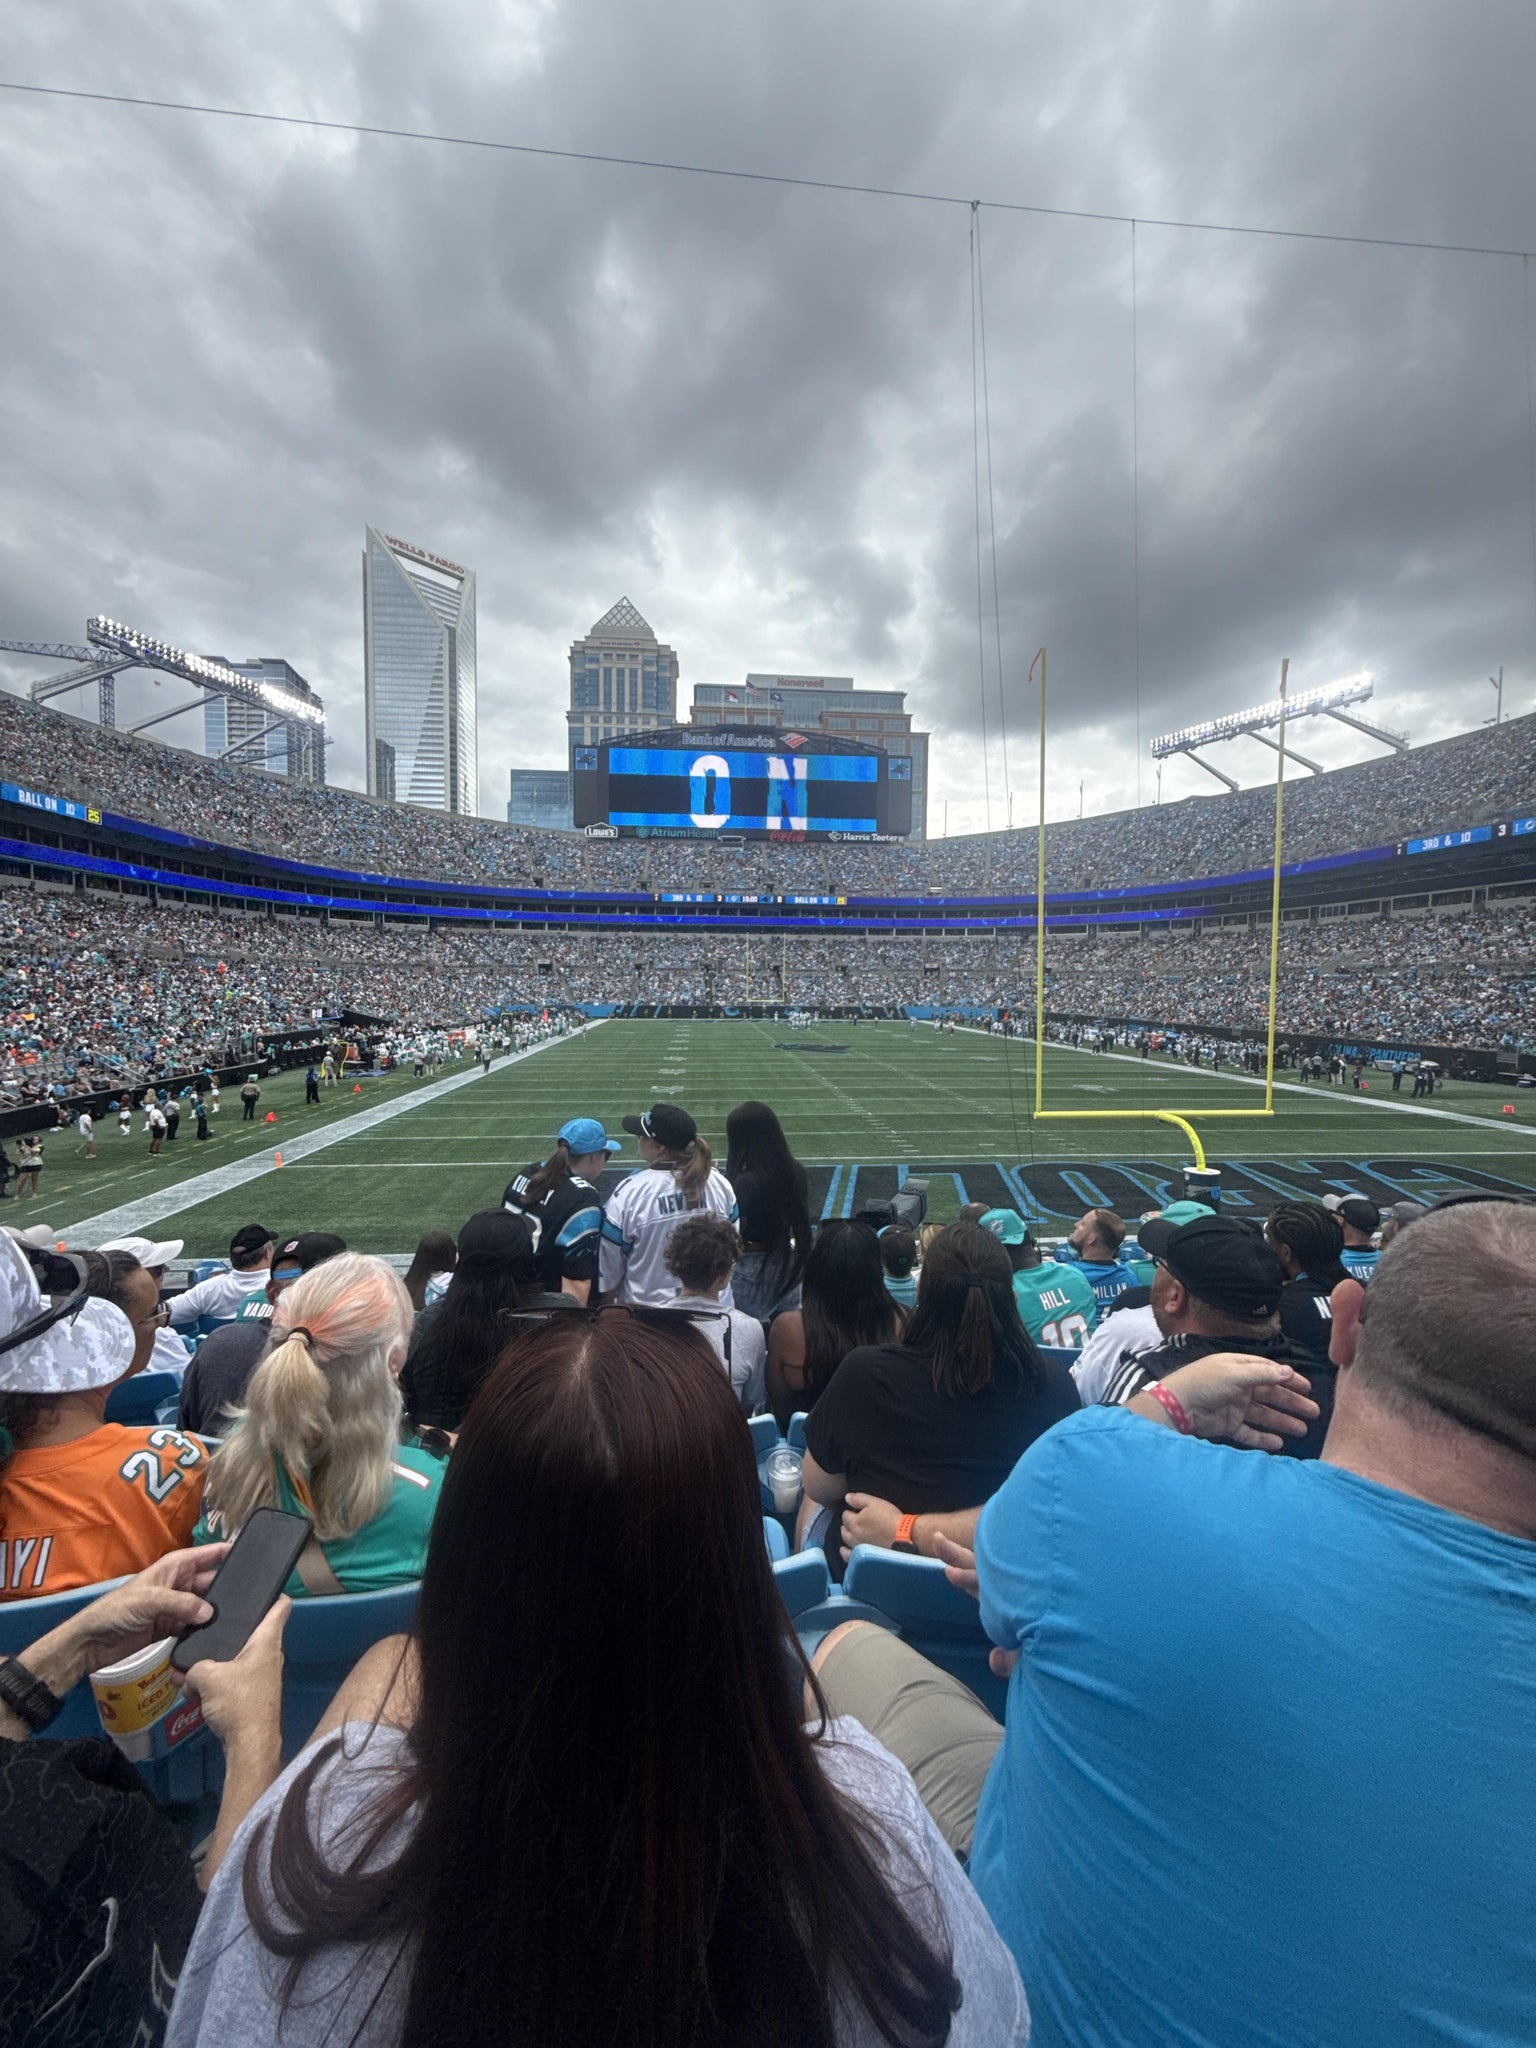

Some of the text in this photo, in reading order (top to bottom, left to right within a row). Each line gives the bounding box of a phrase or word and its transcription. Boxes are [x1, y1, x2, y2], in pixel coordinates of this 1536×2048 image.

[385, 535, 465, 574] WELLS FARGO
[776, 677, 824, 688] Honeywell
[682, 732, 776, 748] Bank of America
[18, 789, 76, 816] BALL ON 10
[87, 809, 100, 824] 25
[651, 827, 719, 839] Atrium Health
[843, 832, 898, 842] Harris Teeter
[1498, 824, 1506, 837] 3
[1422, 838, 1440, 851] 3RD
[1460, 832, 1471, 843] 10
[1040, 1288, 1071, 1311] HILL
[120, 1429, 204, 1505] 23
